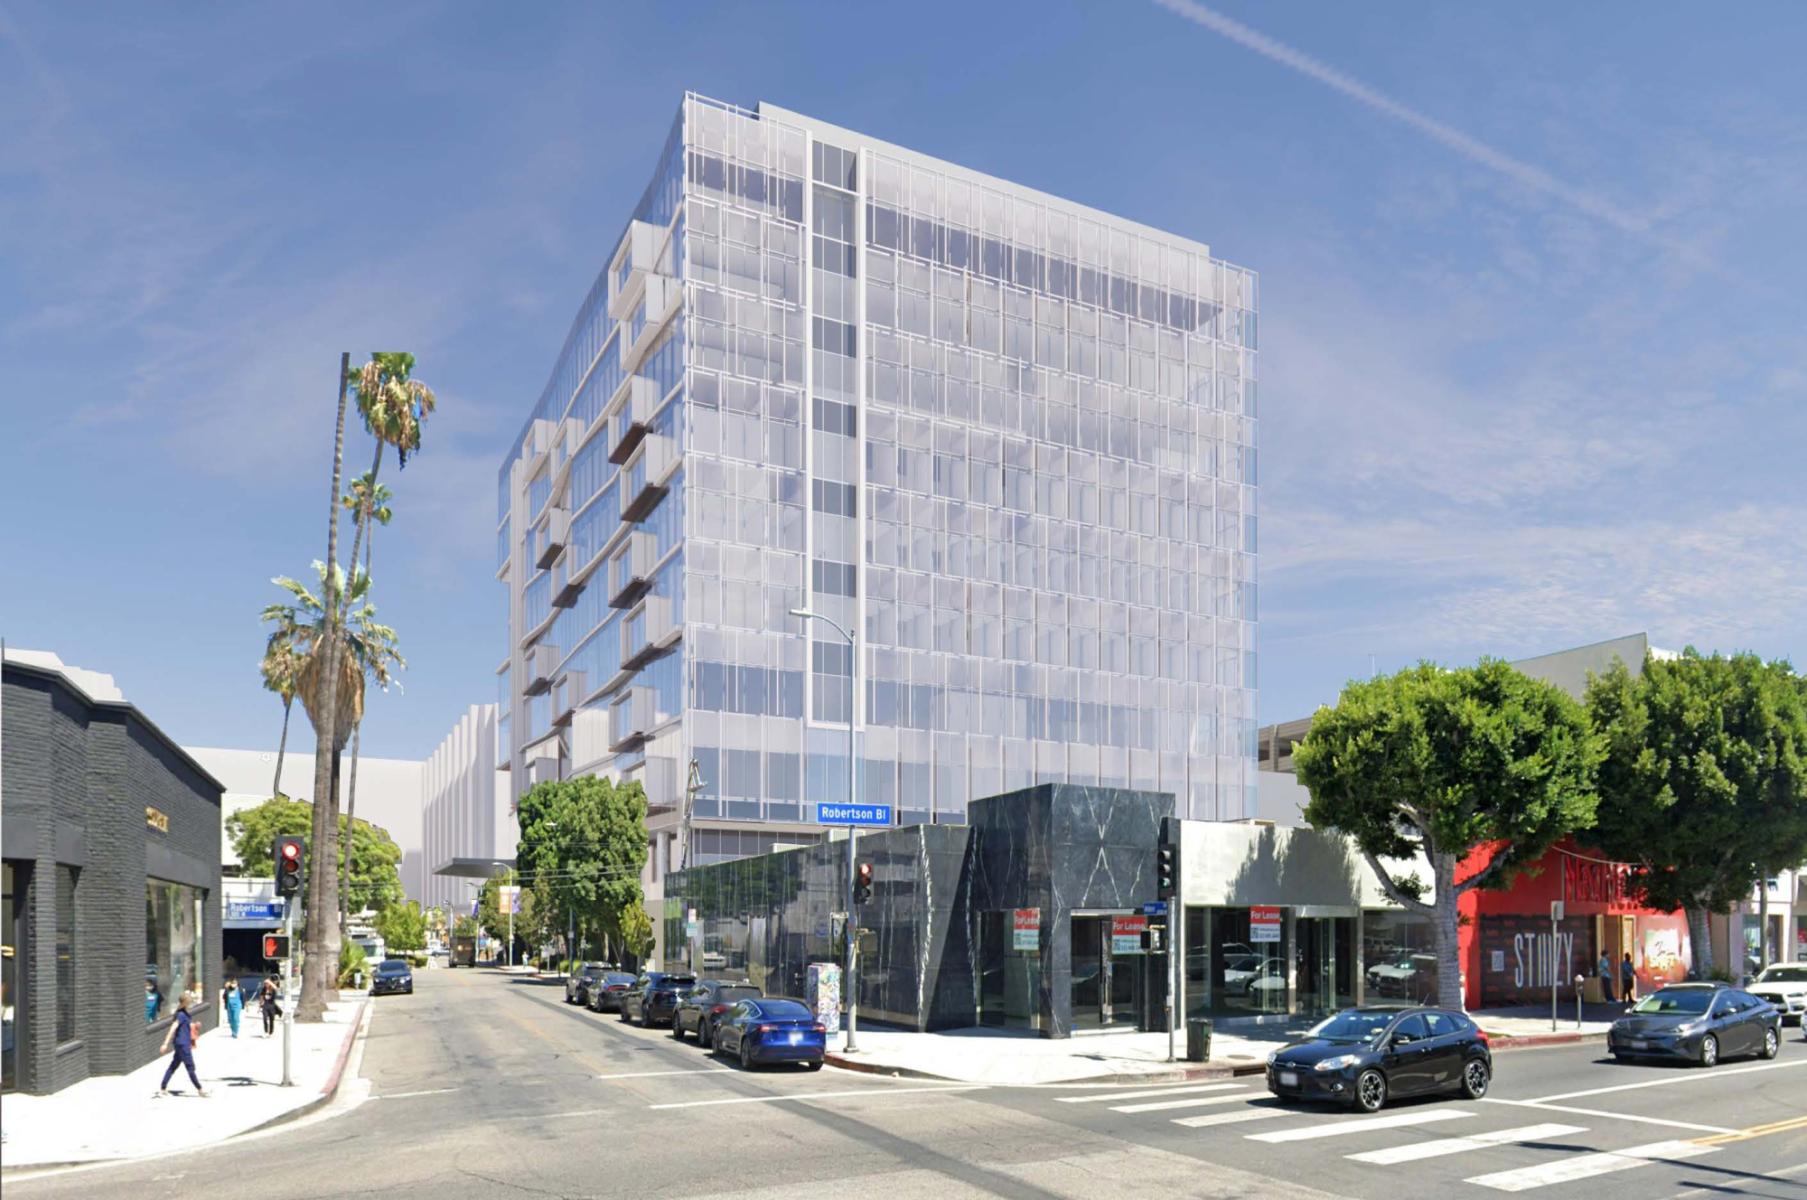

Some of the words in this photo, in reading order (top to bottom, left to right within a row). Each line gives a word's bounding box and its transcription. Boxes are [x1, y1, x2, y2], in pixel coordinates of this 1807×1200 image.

[822, 807, 873, 819] Robertson
[876, 809, 886, 820] Bl
[230, 903, 268, 912] Robertson
[1250, 911, 1261, 919] For
[1262, 911, 1280, 919] Lease
[1113, 921, 1124, 930] For
